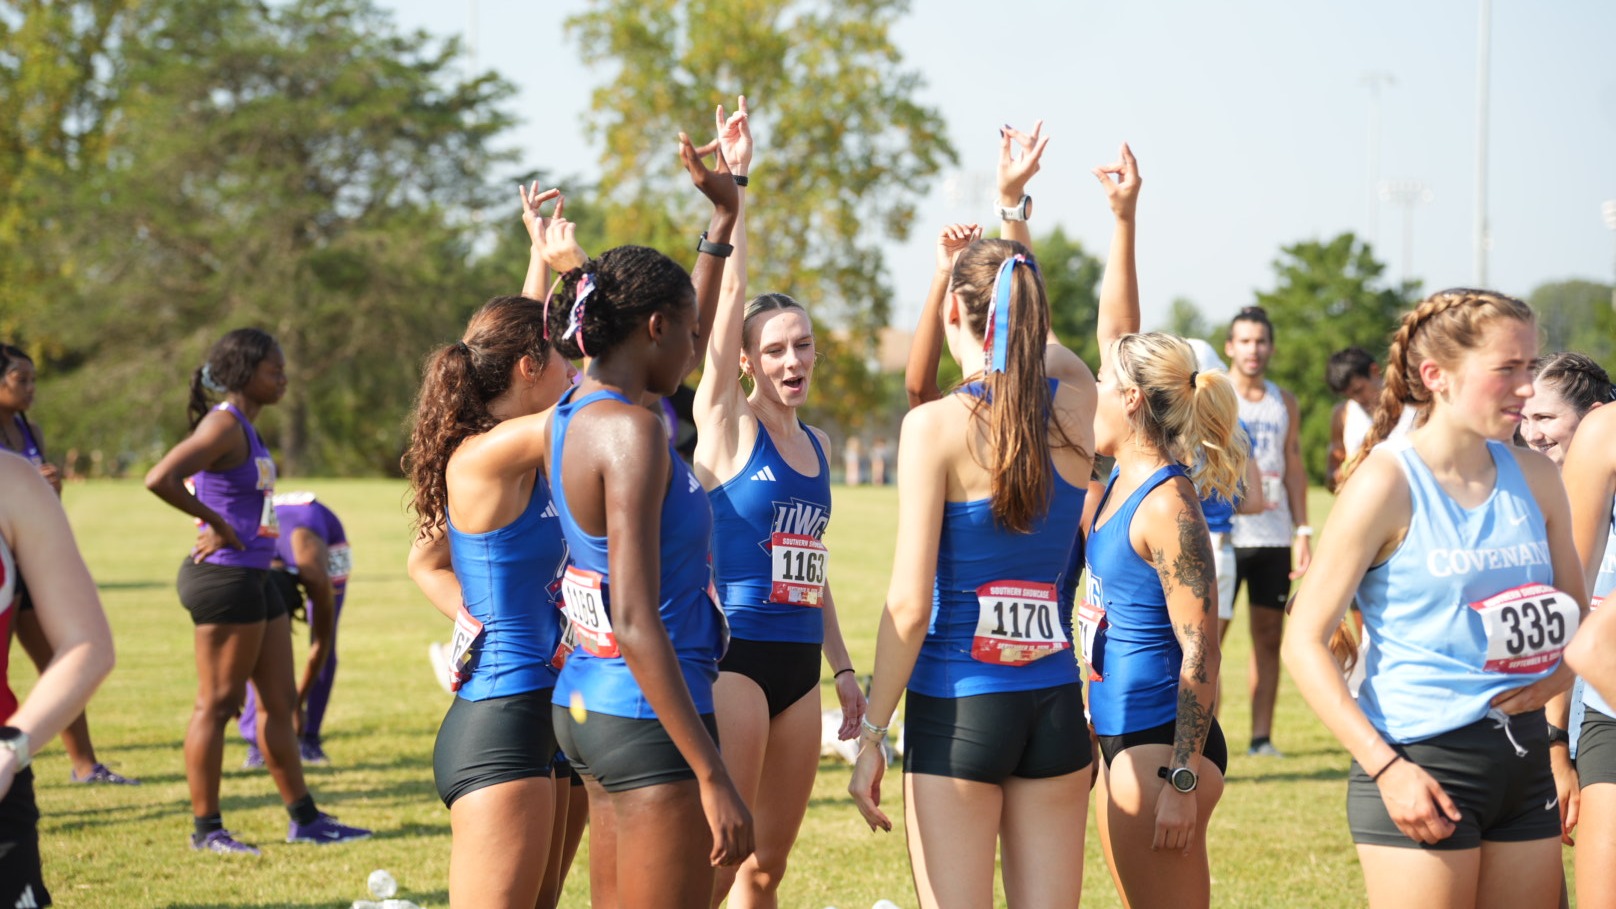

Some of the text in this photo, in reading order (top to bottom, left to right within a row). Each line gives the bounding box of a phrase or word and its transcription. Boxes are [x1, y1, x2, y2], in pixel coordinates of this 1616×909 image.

[782, 537, 809, 547] SOUTHERN
[782, 550, 825, 583] 1163
[1427, 541, 1550, 578] COVENAN
[990, 586, 1050, 599] SOUTHERN SHOWCASE
[991, 601, 1054, 640] 1170
[1501, 597, 1565, 655] 335
[1508, 657, 1541, 669] SEPTEMBER
